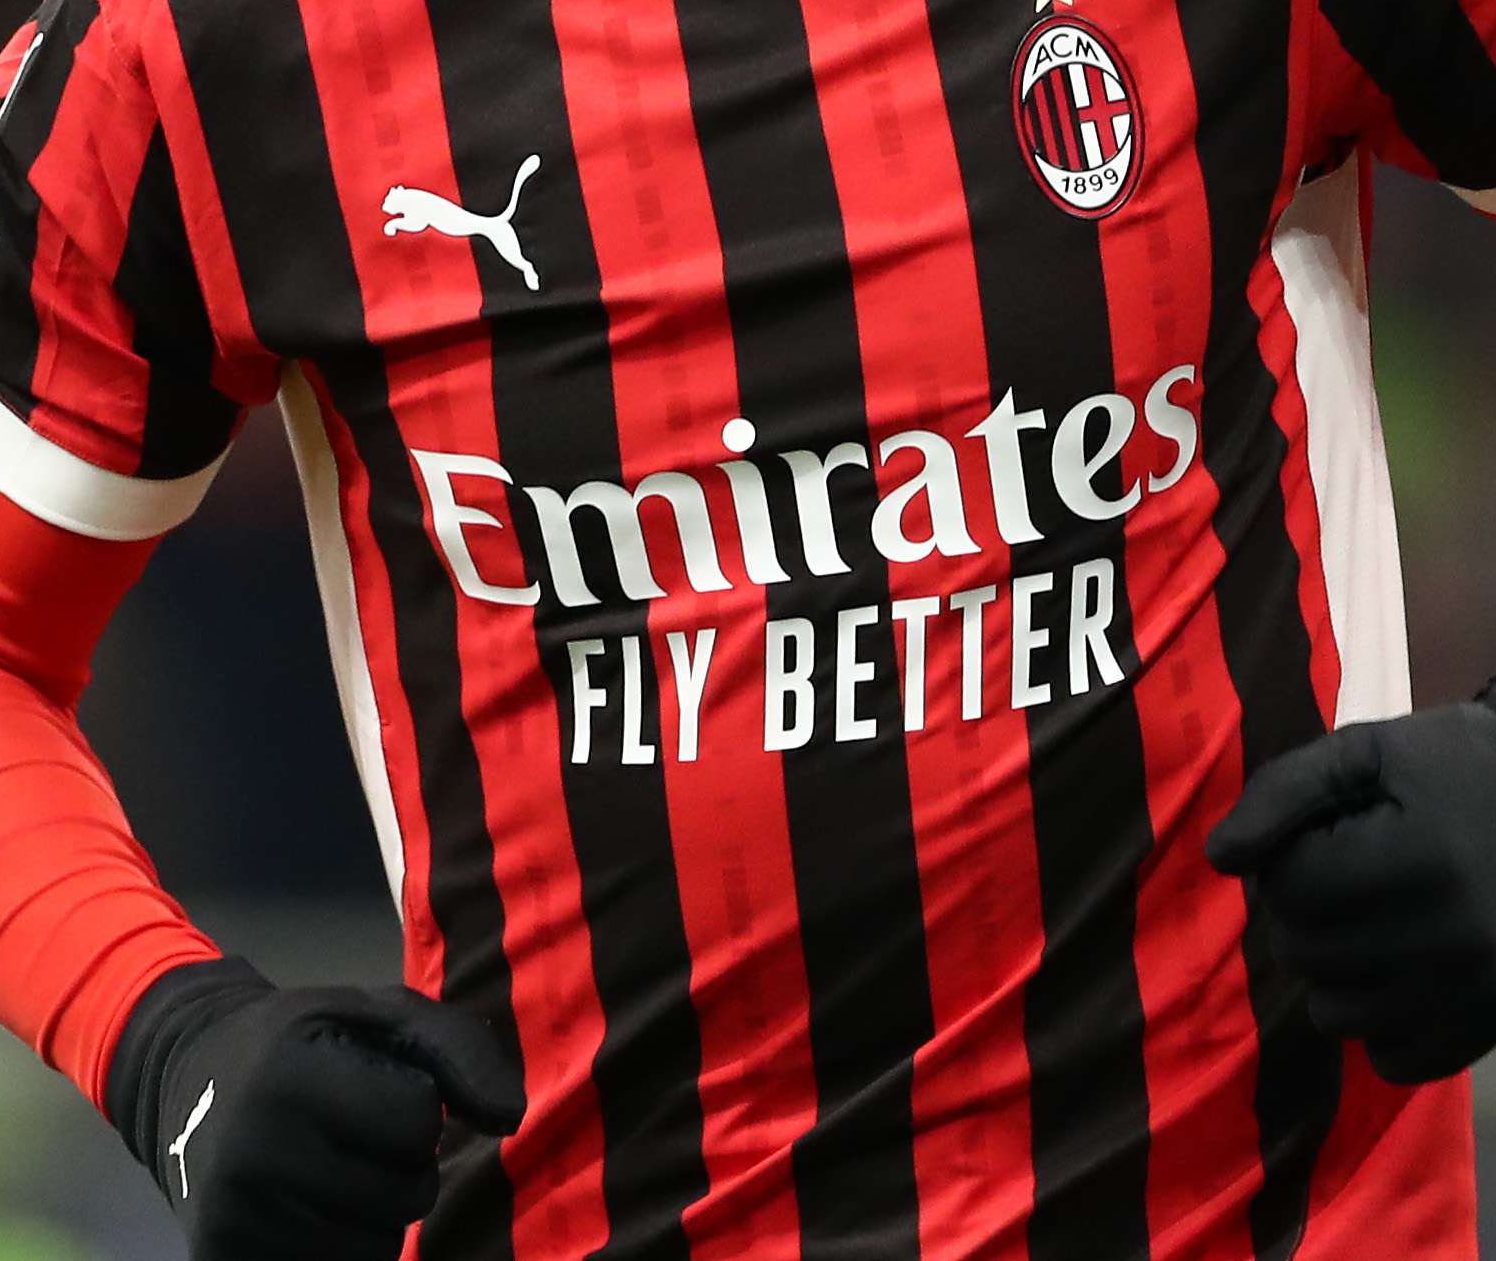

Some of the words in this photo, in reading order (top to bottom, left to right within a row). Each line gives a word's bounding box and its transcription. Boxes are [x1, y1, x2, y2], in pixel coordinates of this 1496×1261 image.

[1032, 33, 1100, 76] ACM
[1061, 167, 1119, 195] 1899
[409, 363, 1198, 608] Emirates
[567, 627, 717, 765] FLY
[763, 557, 1126, 753] BETTER
